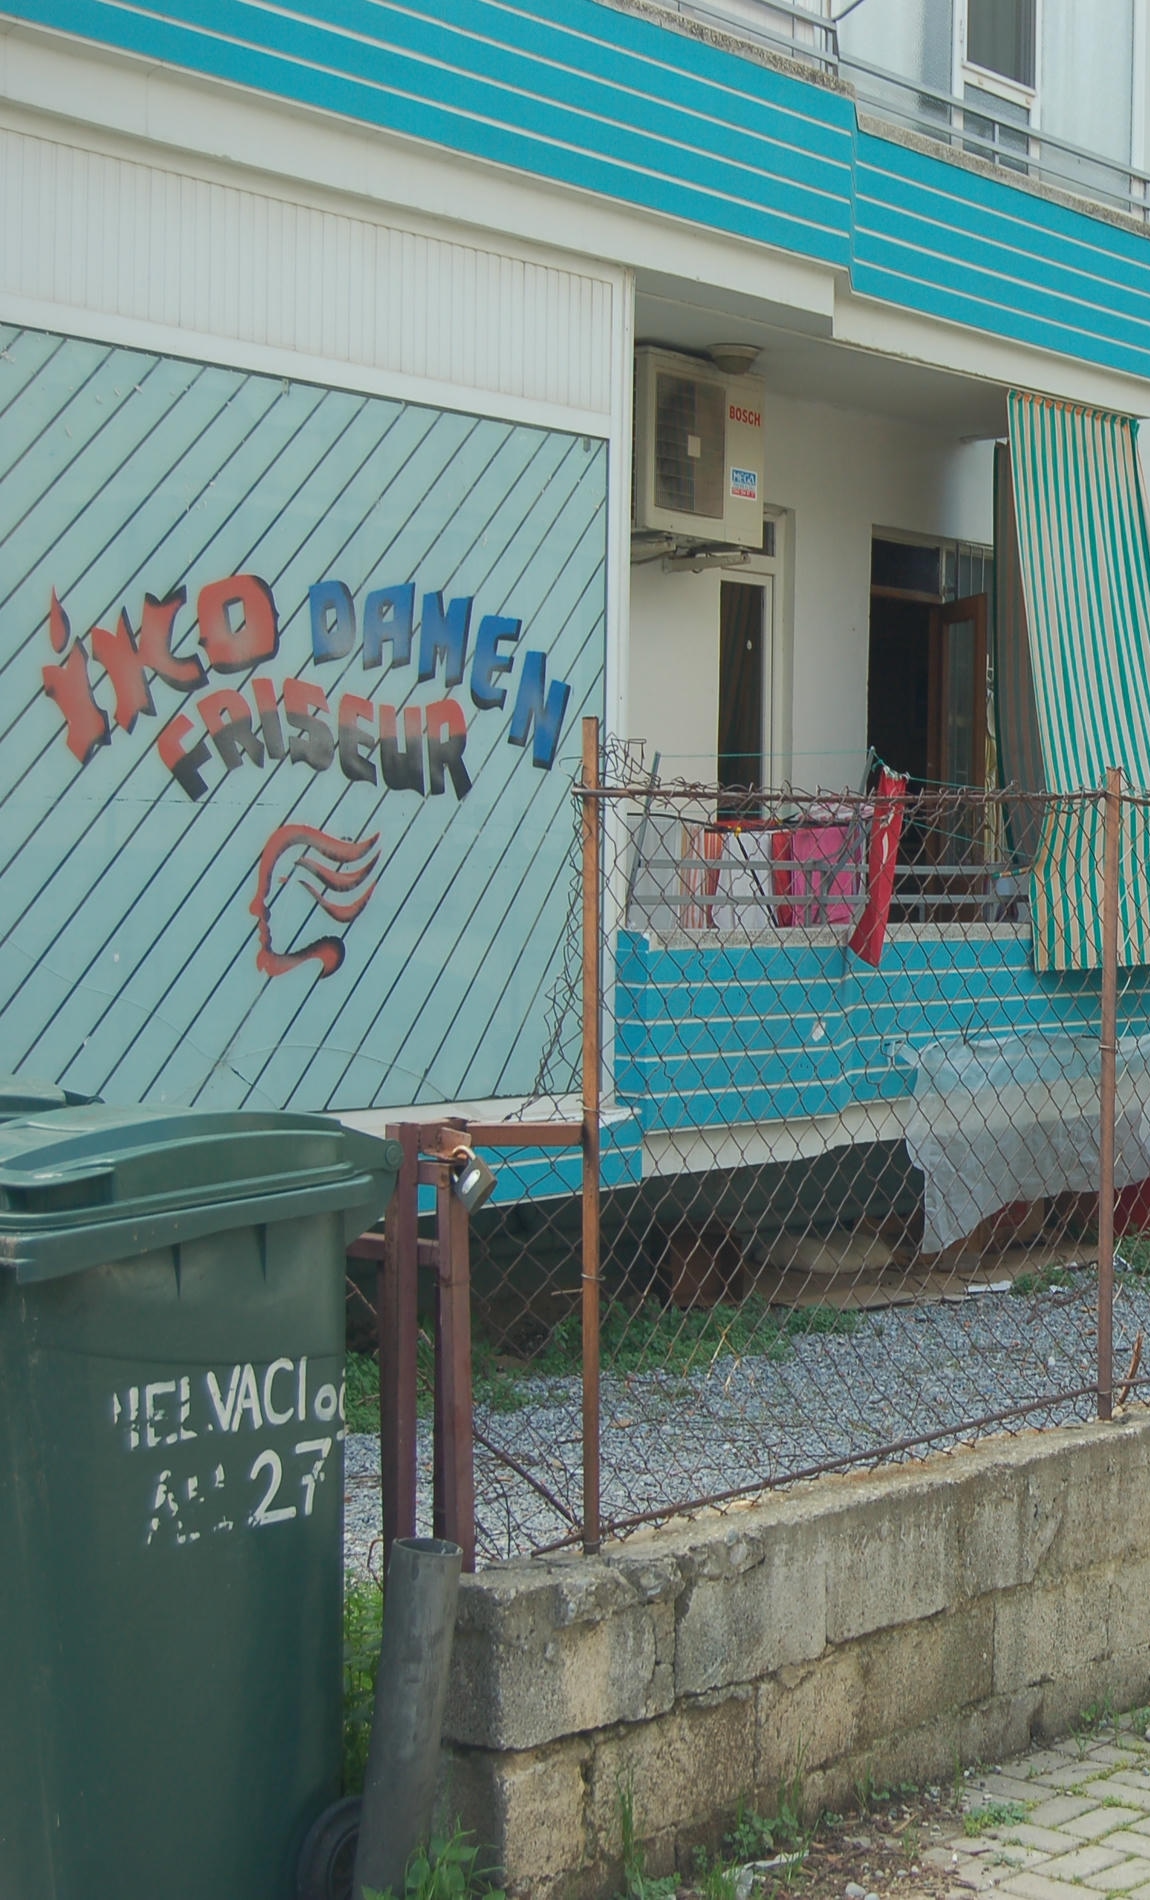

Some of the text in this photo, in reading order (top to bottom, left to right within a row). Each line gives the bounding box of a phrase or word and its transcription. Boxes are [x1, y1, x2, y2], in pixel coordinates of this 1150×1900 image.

[729, 405, 761, 427] BOSCH
[308, 579, 571, 771] DAMEN
[157, 677, 473, 801] FRISEUR
[248, 1437, 332, 1527] 27
